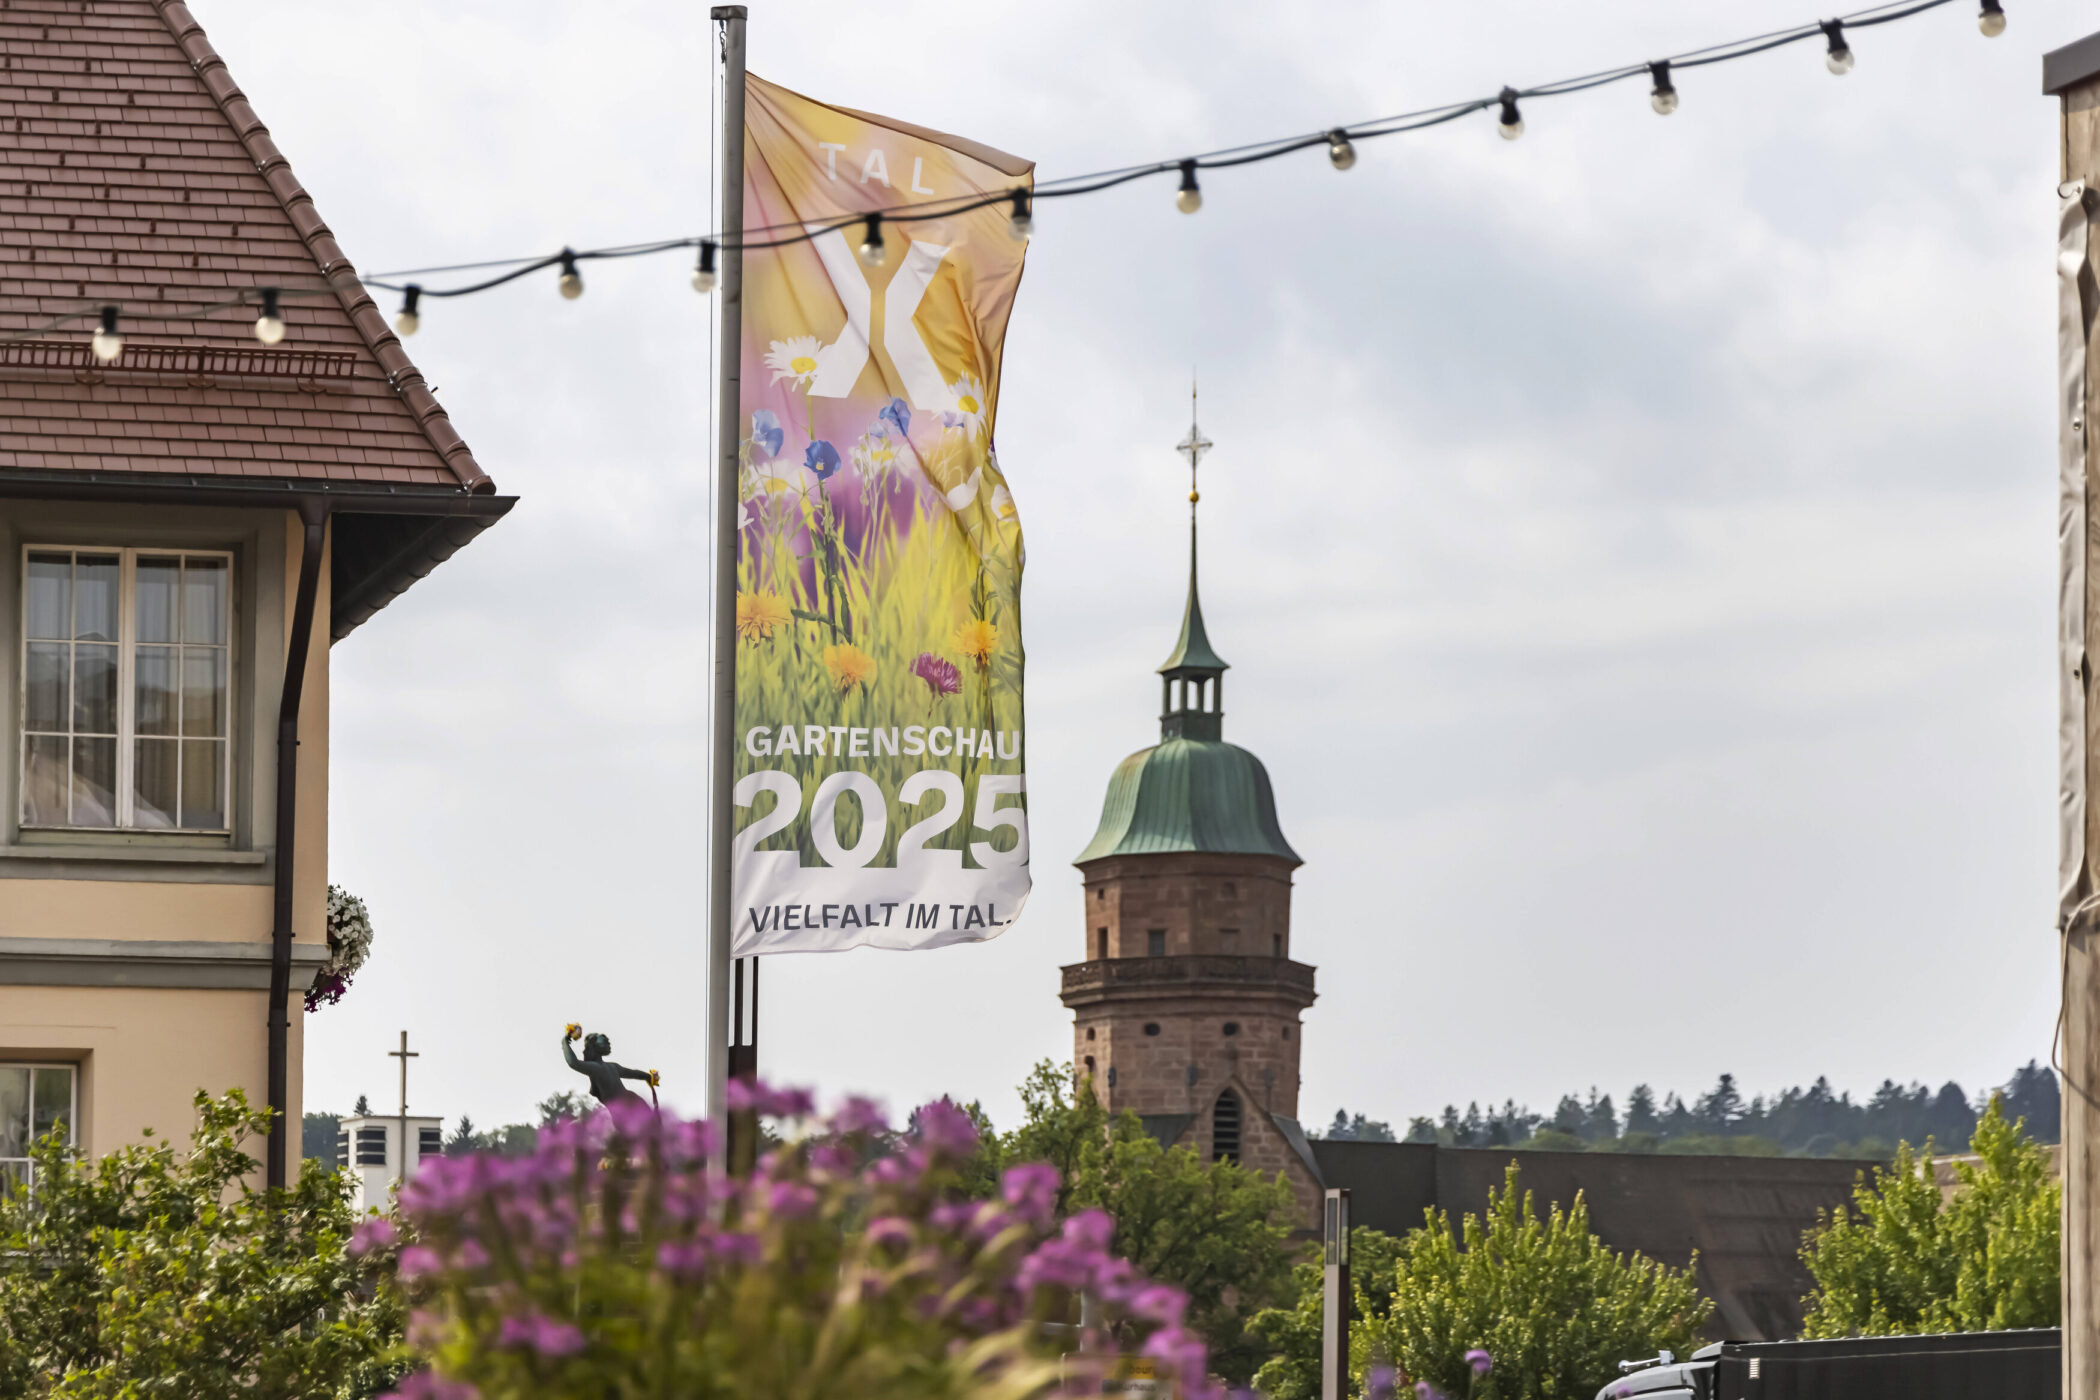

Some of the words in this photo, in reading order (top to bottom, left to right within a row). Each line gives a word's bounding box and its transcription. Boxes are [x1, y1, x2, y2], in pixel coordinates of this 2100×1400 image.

[818, 141, 935, 196] TAL
[745, 725, 1020, 760] GARTENSCHAU
[733, 769, 1029, 871] 2025
[749, 902, 899, 932] VIELFALT
[905, 903, 940, 929] IM
[949, 903, 1012, 929] TAL.
